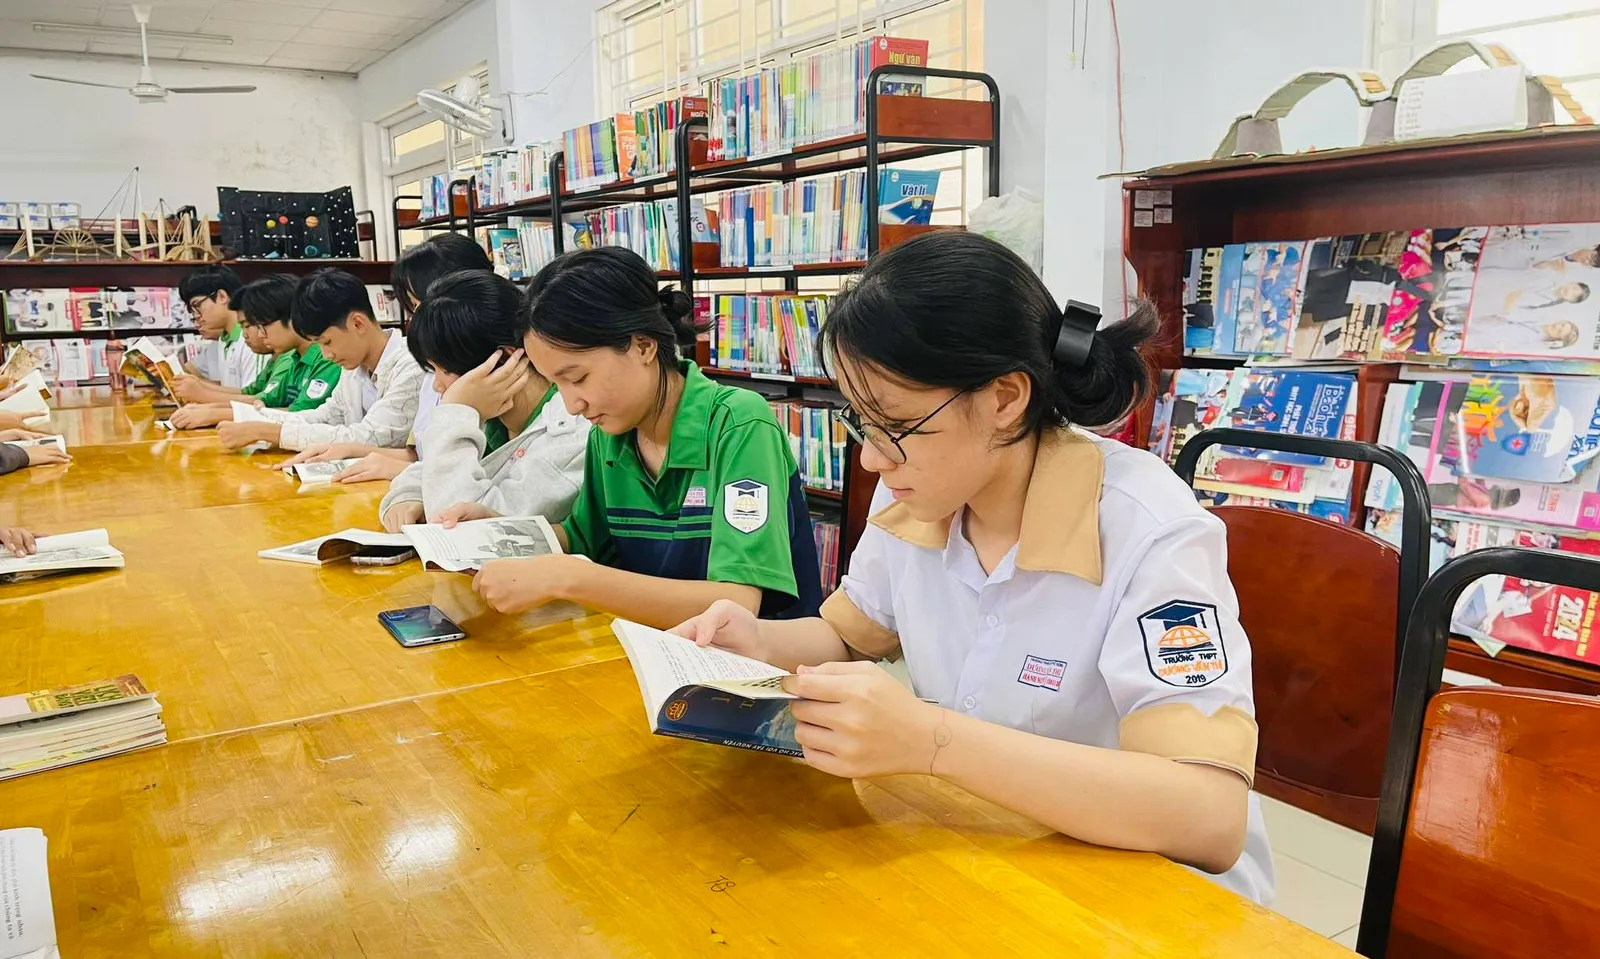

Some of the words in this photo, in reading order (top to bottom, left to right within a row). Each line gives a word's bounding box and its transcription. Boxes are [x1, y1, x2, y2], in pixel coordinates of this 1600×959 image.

[1552, 594, 1585, 642] 2024
[1198, 652, 1217, 660] THPT
[1185, 674, 1207, 684] 2019
